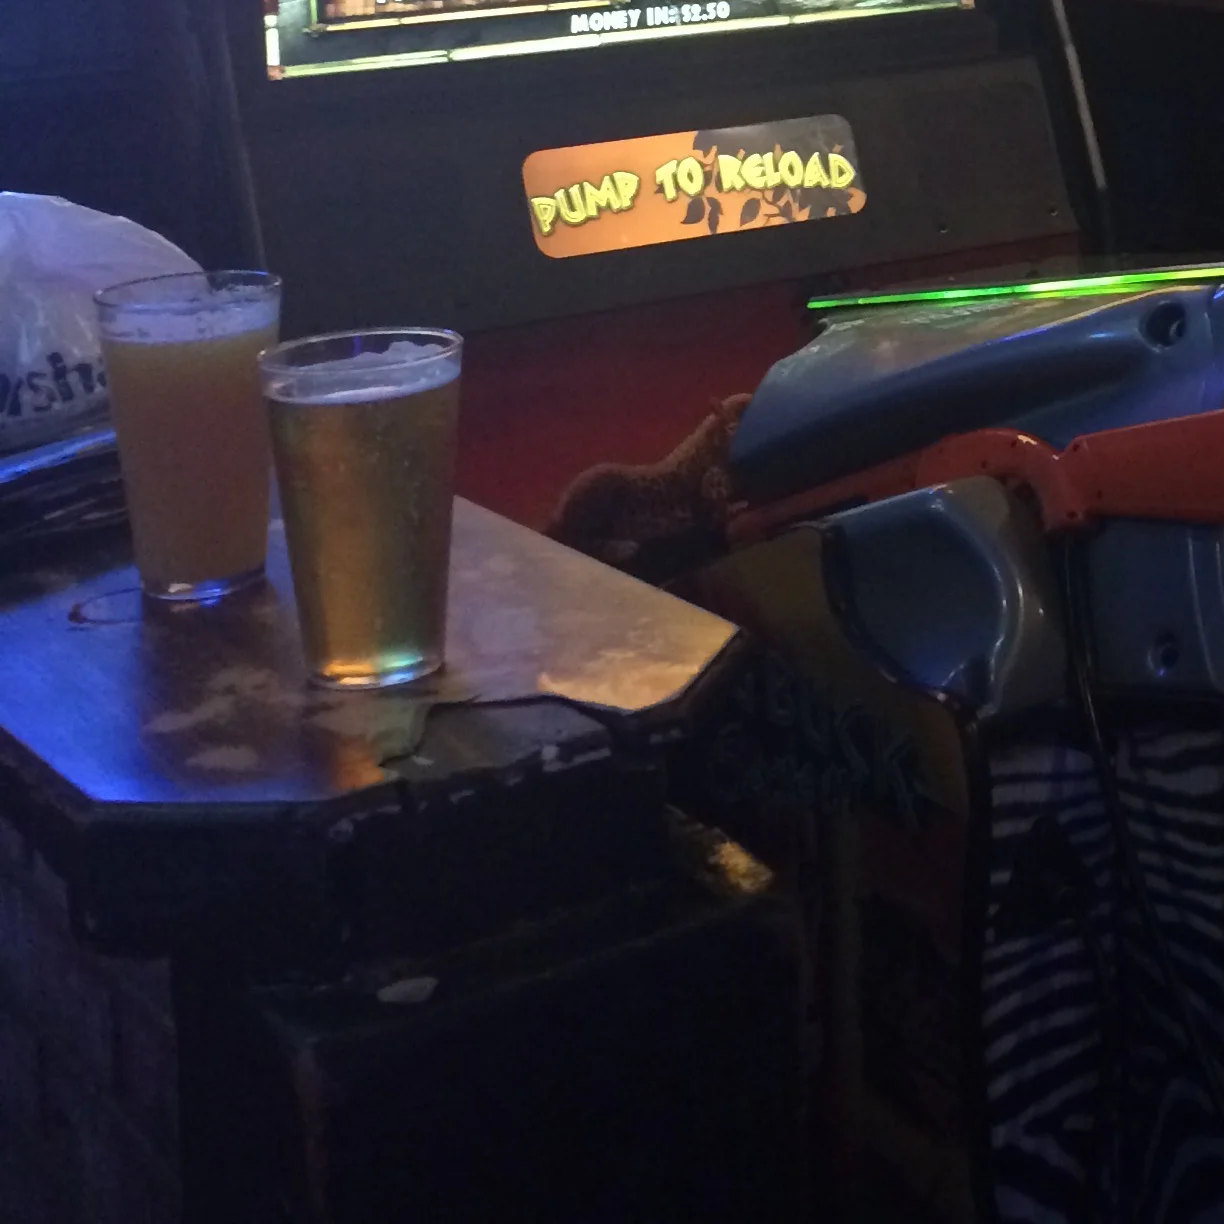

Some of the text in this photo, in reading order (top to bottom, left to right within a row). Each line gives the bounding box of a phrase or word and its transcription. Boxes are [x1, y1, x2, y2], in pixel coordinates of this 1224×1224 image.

[570, 8, 642, 34] MONEY
[646, 6, 679, 27] IN:
[530, 150, 857, 237] PUMP TO RELOAD
